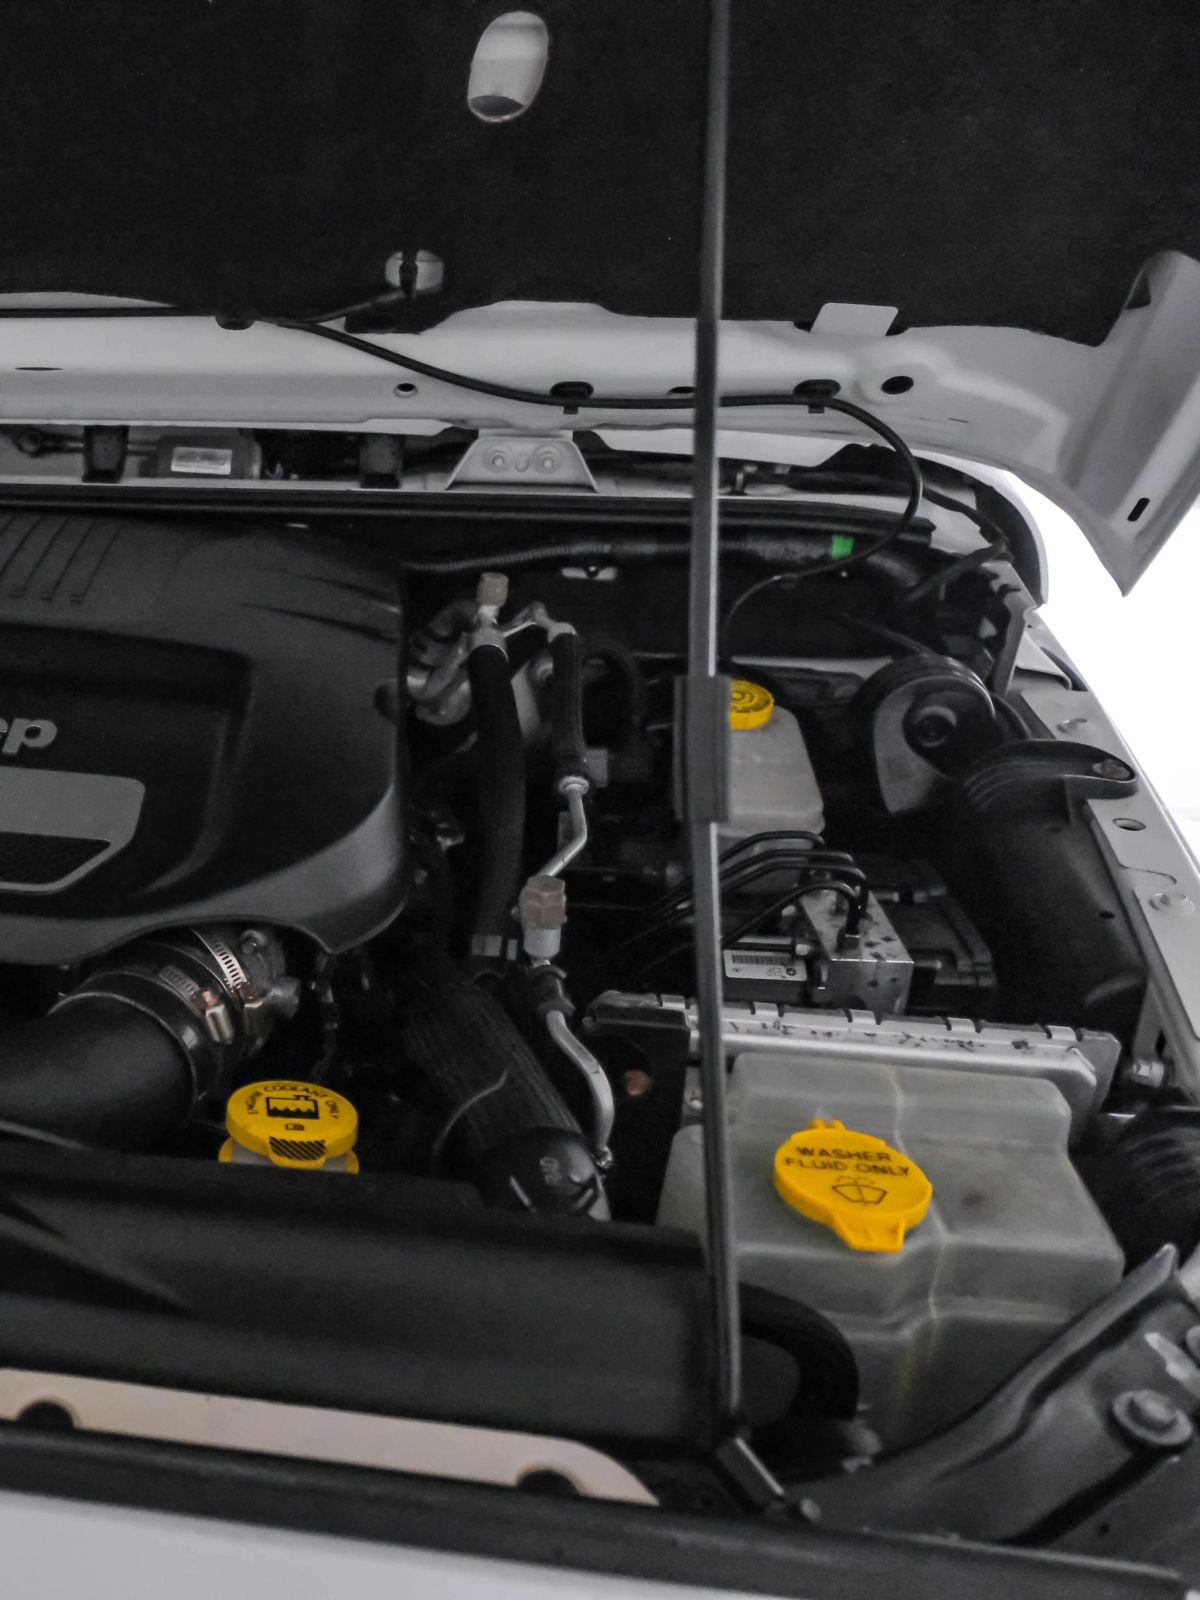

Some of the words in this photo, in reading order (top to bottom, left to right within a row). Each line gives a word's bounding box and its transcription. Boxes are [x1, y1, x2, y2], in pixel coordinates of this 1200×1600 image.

[264, 1085, 327, 1098] COOLANT
[796, 1146, 892, 1162] WASHER
[784, 1157, 848, 1172] FLUID
[856, 1162, 910, 1176] ONLY
